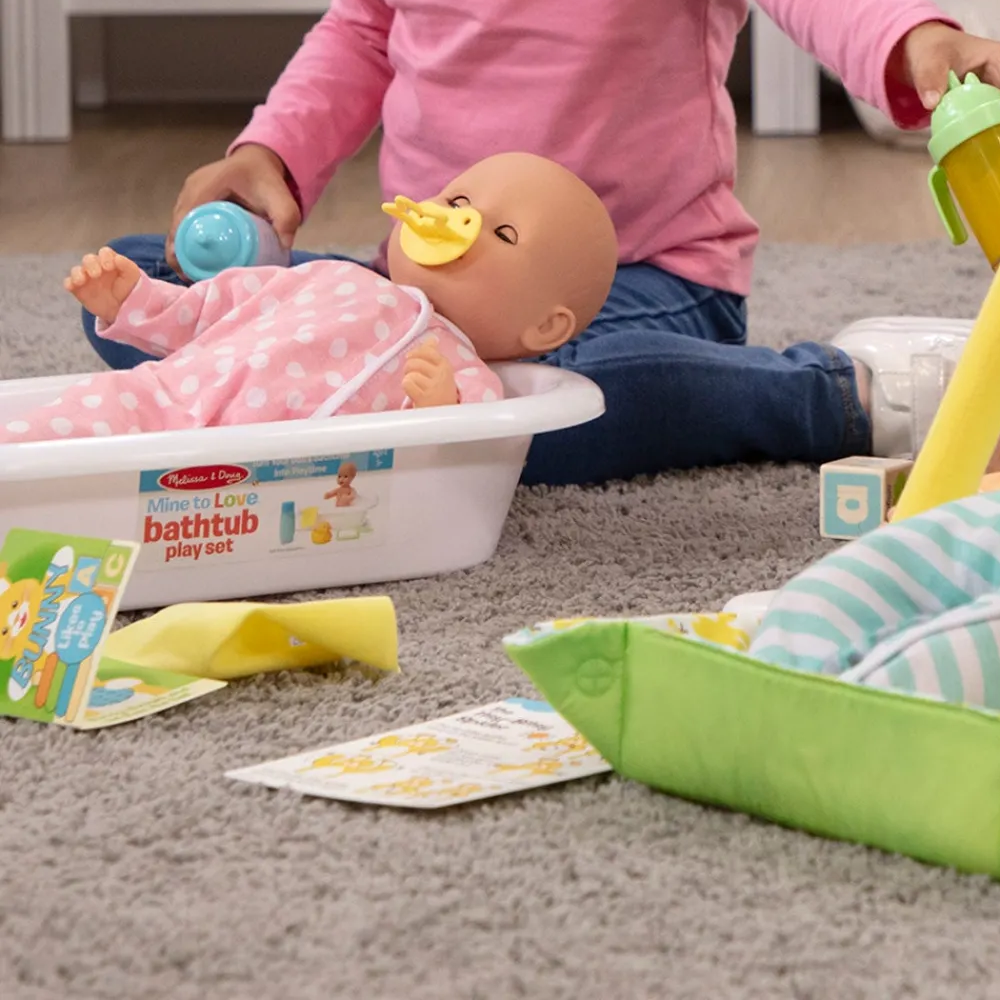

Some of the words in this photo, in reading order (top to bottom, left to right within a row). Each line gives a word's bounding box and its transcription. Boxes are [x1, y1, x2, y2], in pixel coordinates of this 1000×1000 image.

[167, 473, 208, 488] Melissa
[210, 471, 217, 481] &
[218, 470, 243, 484] Doug
[147, 497, 190, 513] Mine
[193, 496, 211, 509] to
[214, 492, 259, 508] Love
[143, 508, 260, 544] bathtub
[164, 541, 203, 562] play
[205, 538, 234, 555] set
[12, 563, 69, 688] BUNNY
[57, 604, 83, 650] Likes
[77, 610, 105, 650] Play
